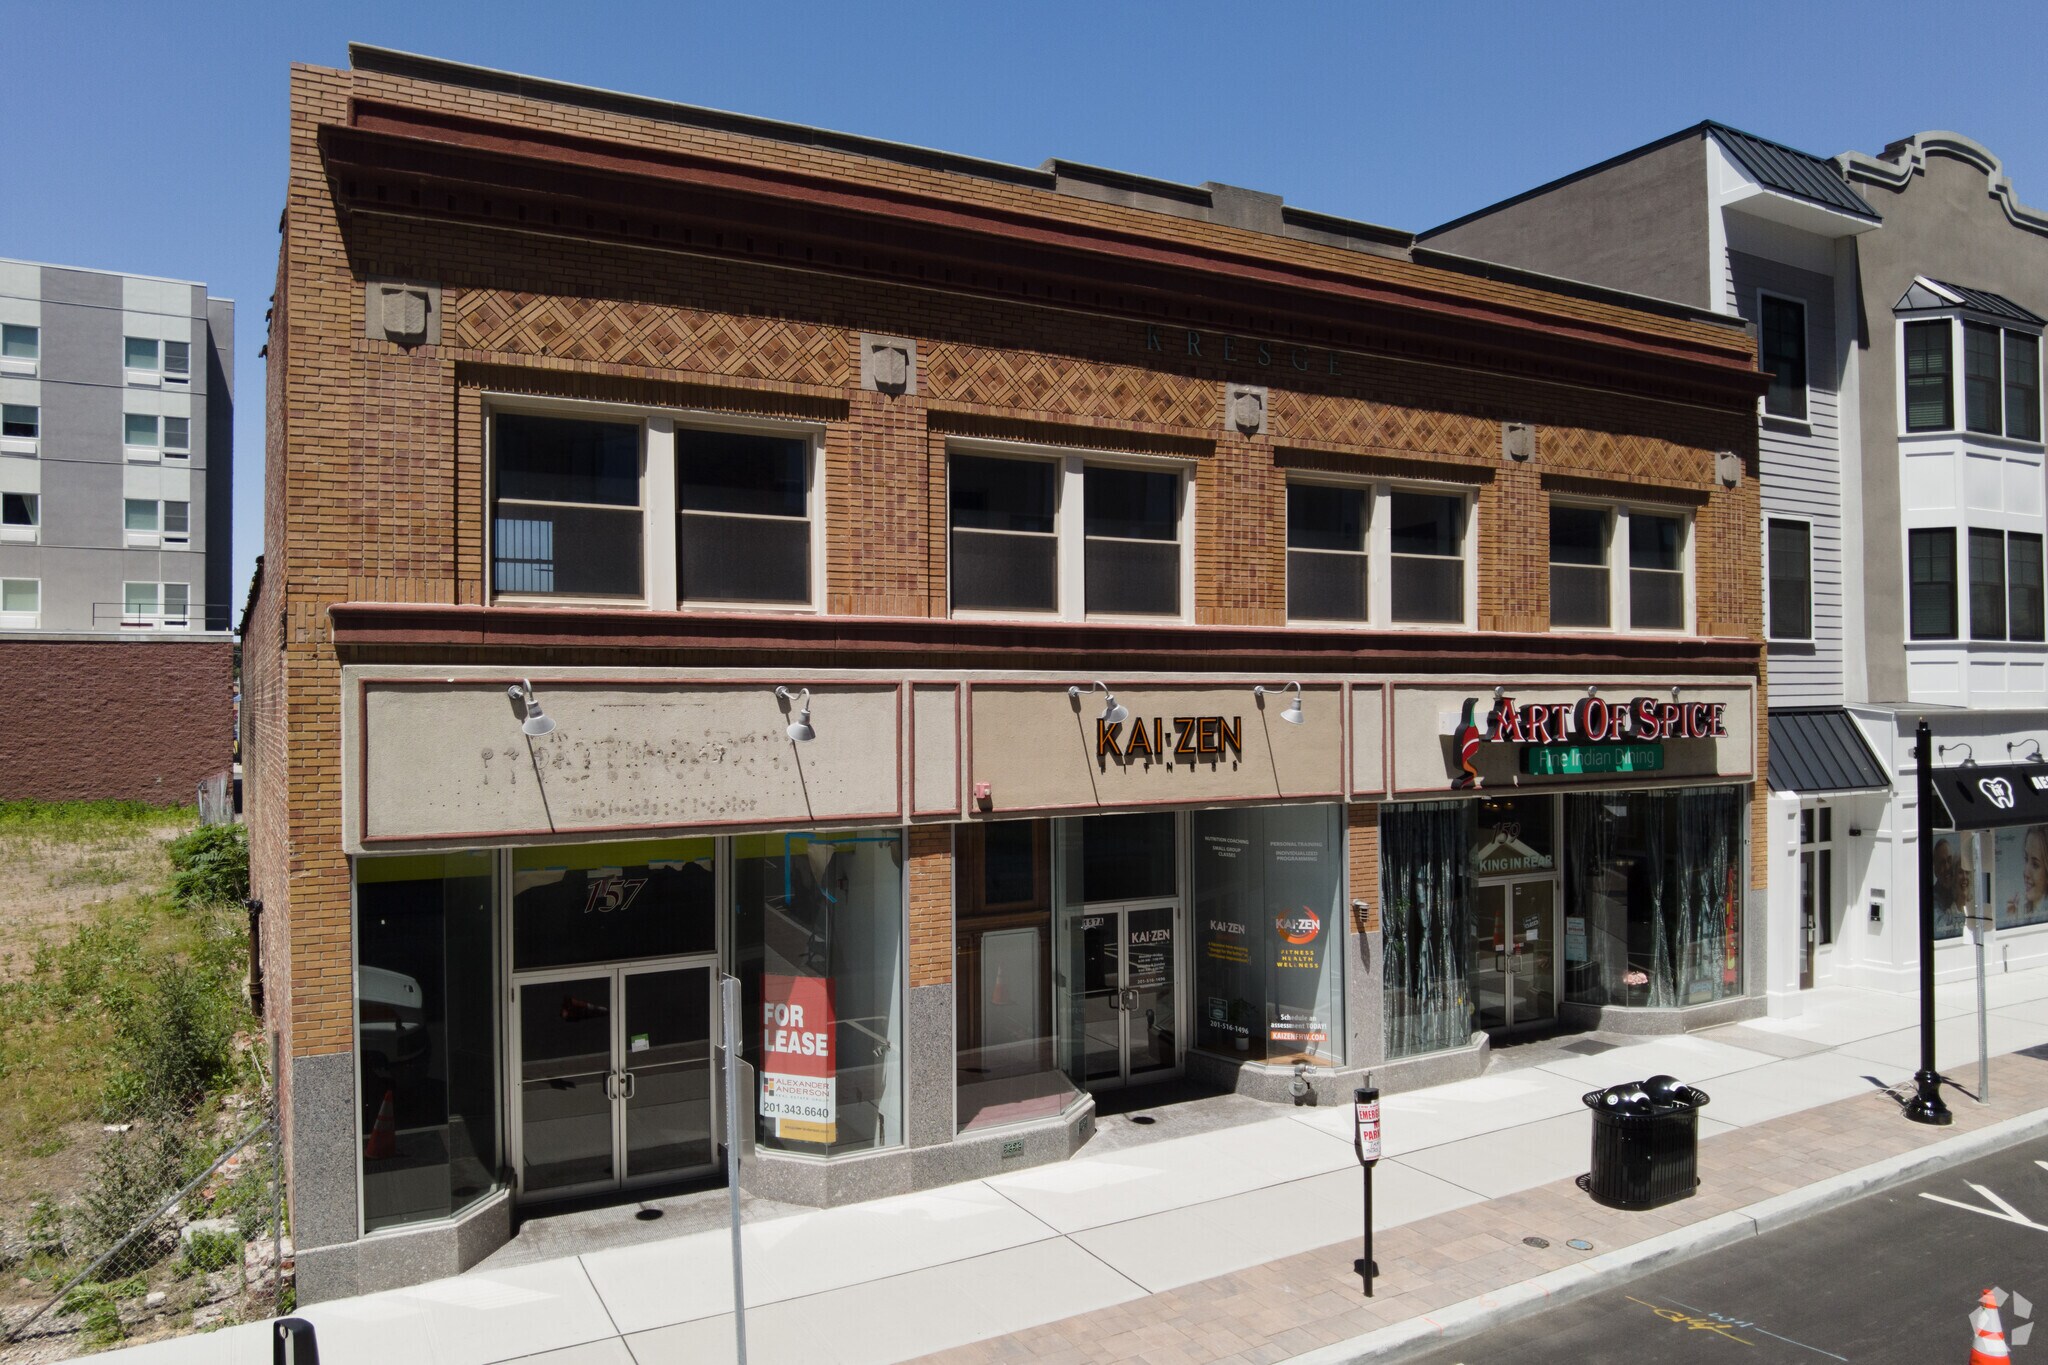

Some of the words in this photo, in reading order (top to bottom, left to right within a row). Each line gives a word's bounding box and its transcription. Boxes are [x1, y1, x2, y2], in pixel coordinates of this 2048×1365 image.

[1146, 325, 1342, 376] KRESGE
[1490, 697, 1574, 744] ART
[1581, 698, 1631, 741] OF
[1636, 698, 1729, 741] SPICE
[1539, 750, 1567, 767] Fine
[1571, 748, 1611, 766] Indian
[1615, 748, 1655, 768] Dining
[1492, 822, 1521, 844] 159
[1510, 857, 1521, 870] IN
[1523, 855, 1552, 868] REAR
[584, 877, 648, 913] 157
[764, 1002, 804, 1028] FOR
[1280, 1013, 1307, 1021] Schedule
[1210, 1020, 1249, 1035] 201-516-1496
[764, 1028, 828, 1057] LEASE
[776, 1078, 829, 1089] ALEXANDER
[776, 1086, 829, 1097] ANDERSON
[764, 1102, 829, 1118] 201.343.6640
[1359, 1109, 1380, 1120] EMERG
